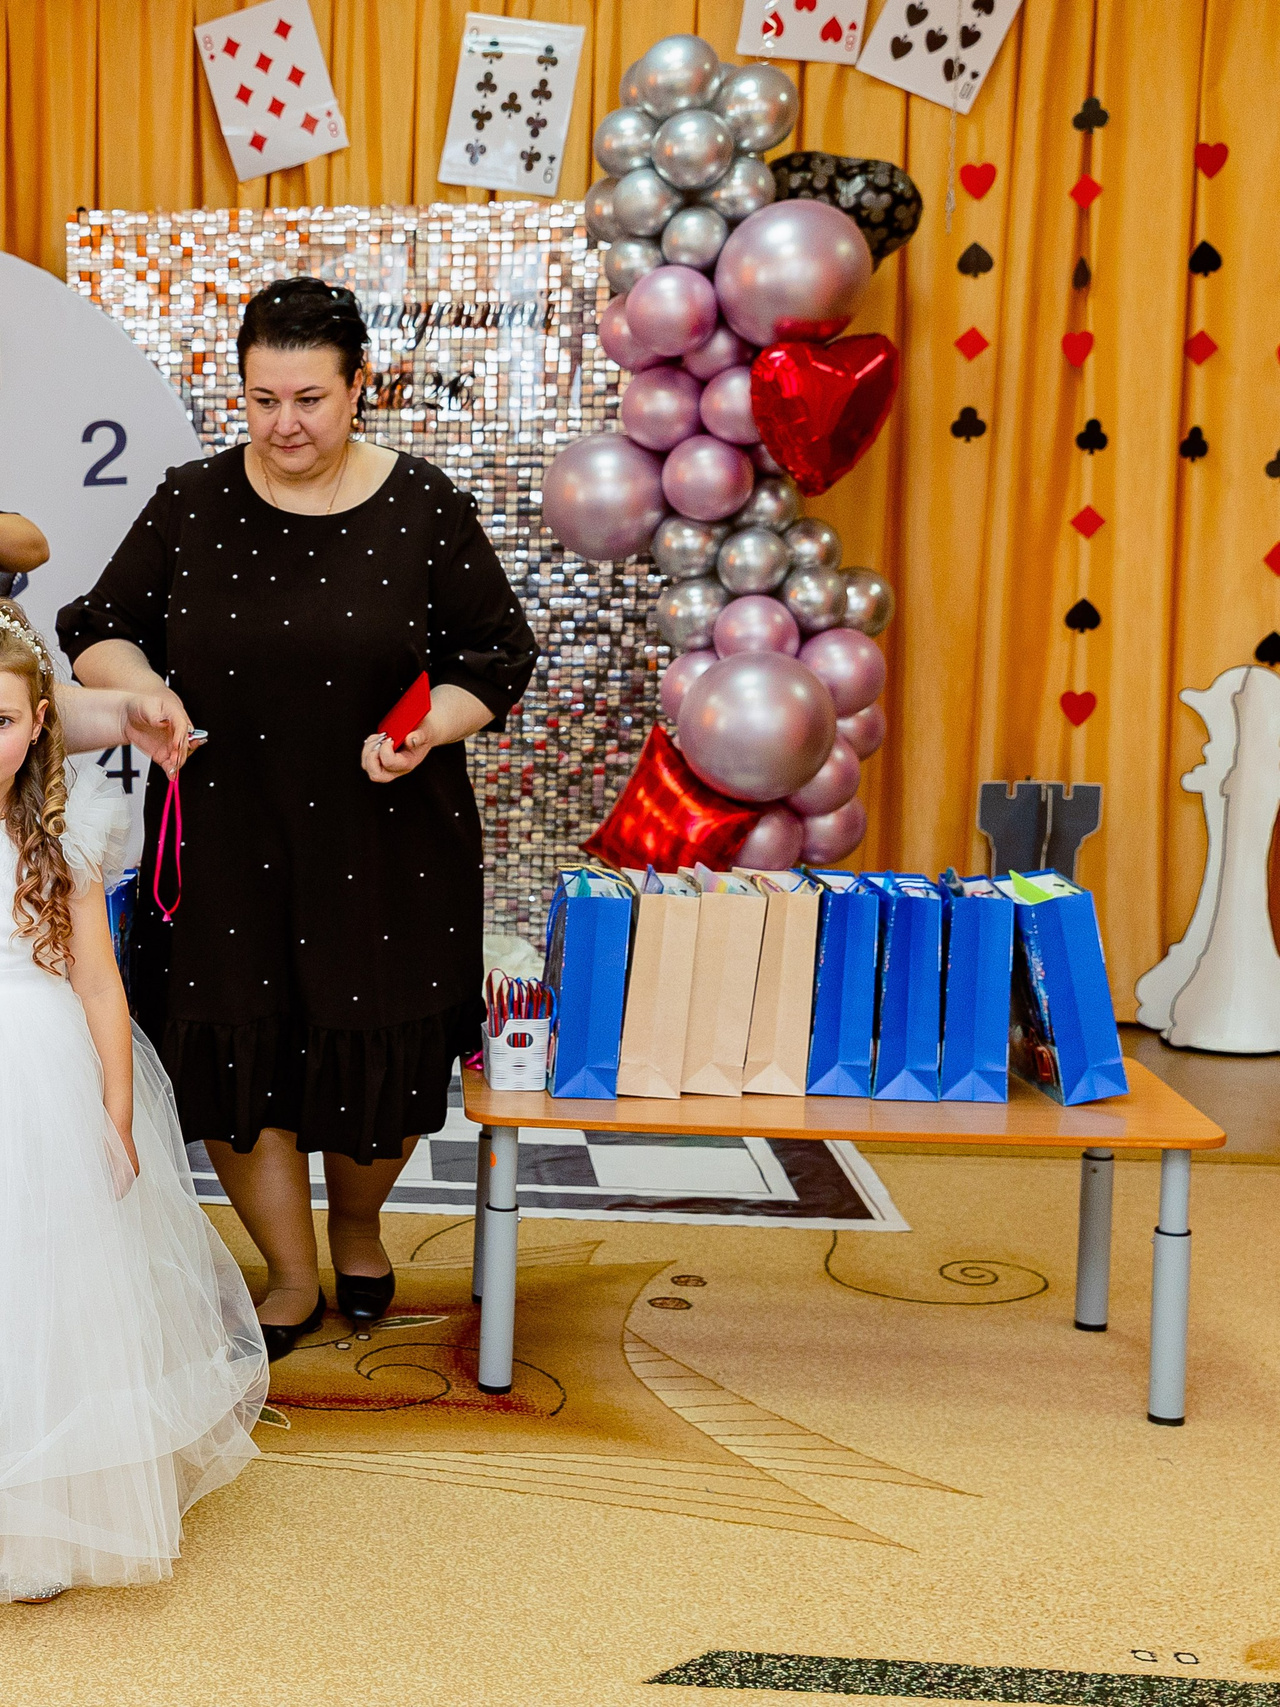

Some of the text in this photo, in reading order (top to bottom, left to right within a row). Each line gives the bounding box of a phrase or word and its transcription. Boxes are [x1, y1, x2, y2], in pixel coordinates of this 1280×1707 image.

[202, 34, 214, 51] 8
[327, 120, 340, 138] 8
[543, 167, 554, 185] 9
[81, 420, 128, 488] 2
[96, 744, 140, 795] 4
